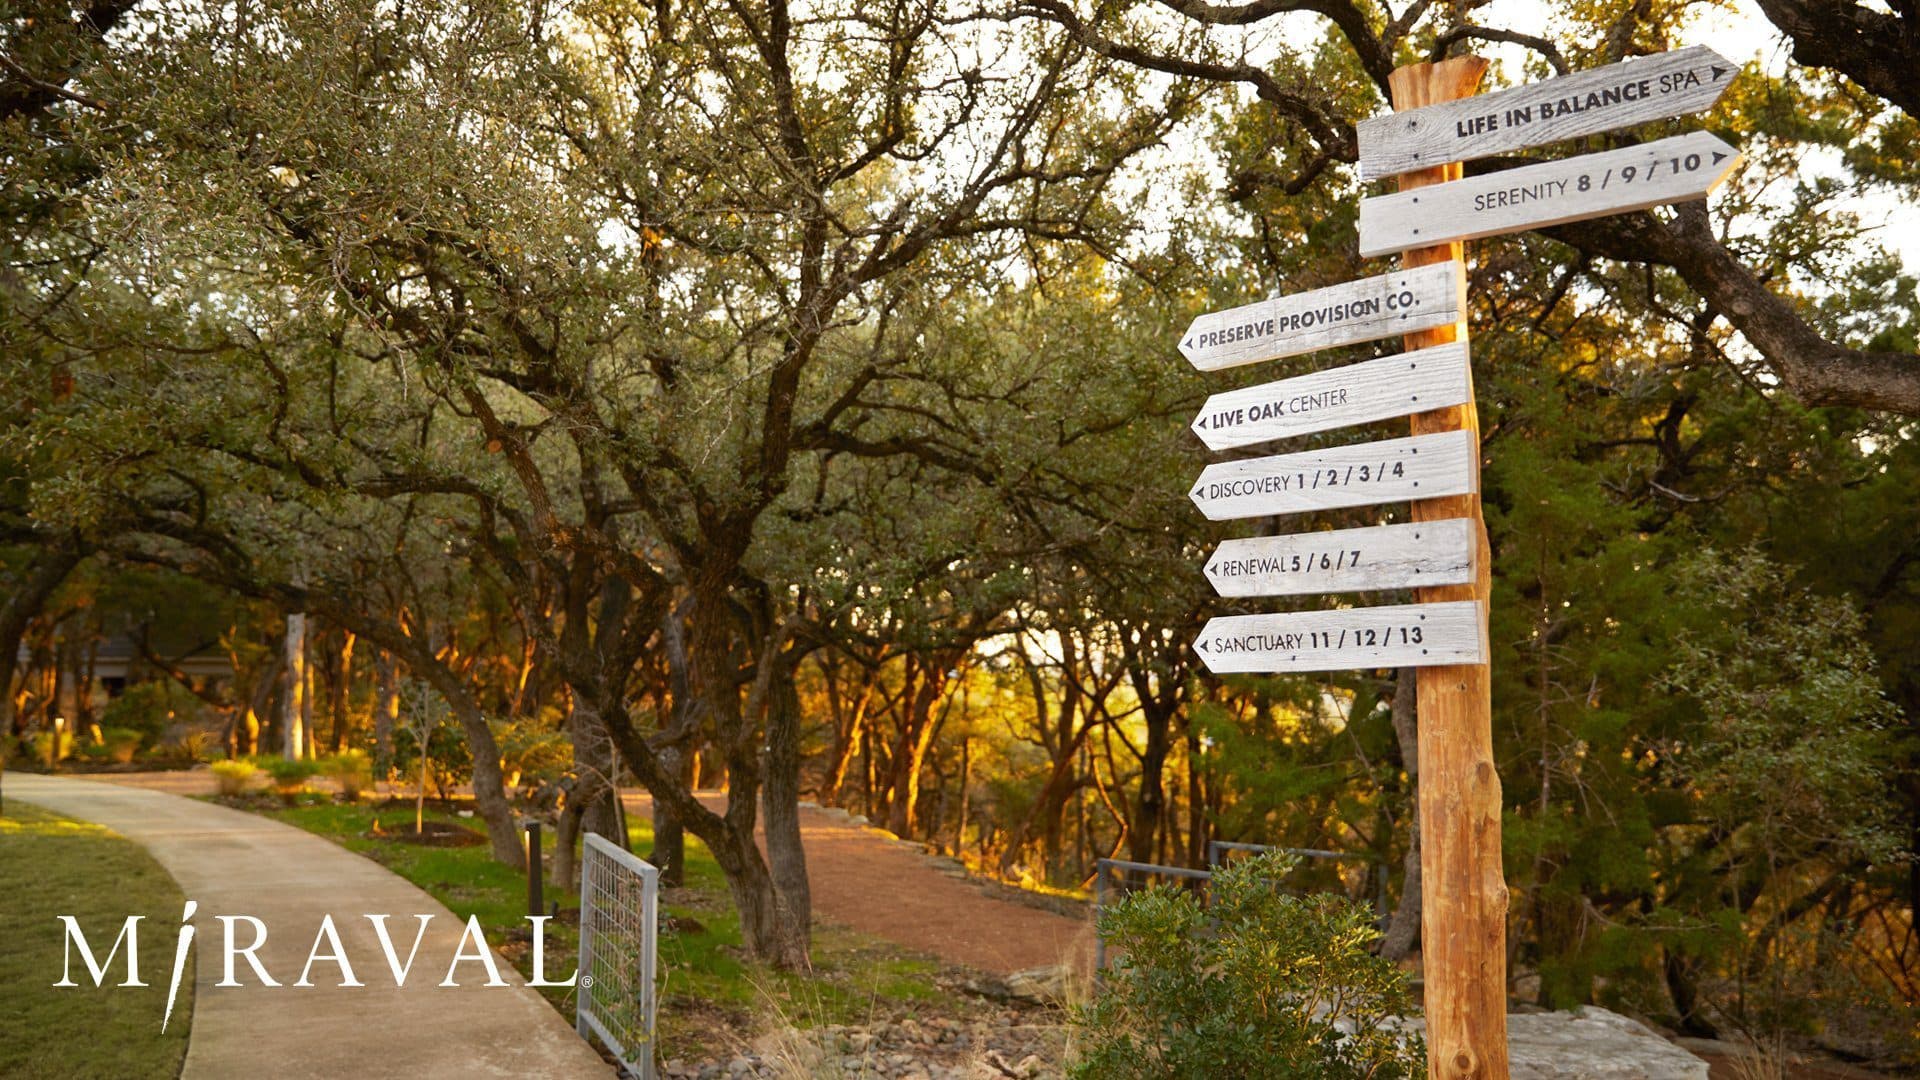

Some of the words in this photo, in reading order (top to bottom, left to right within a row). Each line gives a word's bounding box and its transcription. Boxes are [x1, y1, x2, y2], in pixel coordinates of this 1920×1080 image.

[1456, 114, 1498, 138] LIFE
[1506, 107, 1531, 128] IN
[1540, 80, 1650, 120] BALANCE
[1660, 70, 1700, 94] SPA
[1474, 179, 1568, 212] SERENITY
[1577, 174, 1590, 192] 8
[1622, 166, 1636, 184] 9
[1670, 154, 1700, 174] 10
[1199, 319, 1274, 348] PRESERVE
[1280, 298, 1380, 332] PROVISION
[1386, 290, 1420, 311] CO.
[1212, 409, 1243, 430] LIVE
[1248, 401, 1285, 422] OAK
[1289, 388, 1348, 414] CENTER
[1210, 475, 1291, 499] DISCOVERY
[1298, 474, 1304, 489] 1
[1328, 470, 1338, 486] 2
[1359, 466, 1370, 482] 3
[1392, 461, 1404, 478] 4
[1223, 556, 1286, 577] RENEWAL
[1292, 556, 1300, 572] 5
[1320, 553, 1330, 570] 6
[1350, 551, 1360, 568] 7
[1215, 633, 1304, 654] SANCTUARY
[1310, 632, 1329, 648] 11
[1354, 630, 1376, 646] 12
[1400, 626, 1424, 644] 13
